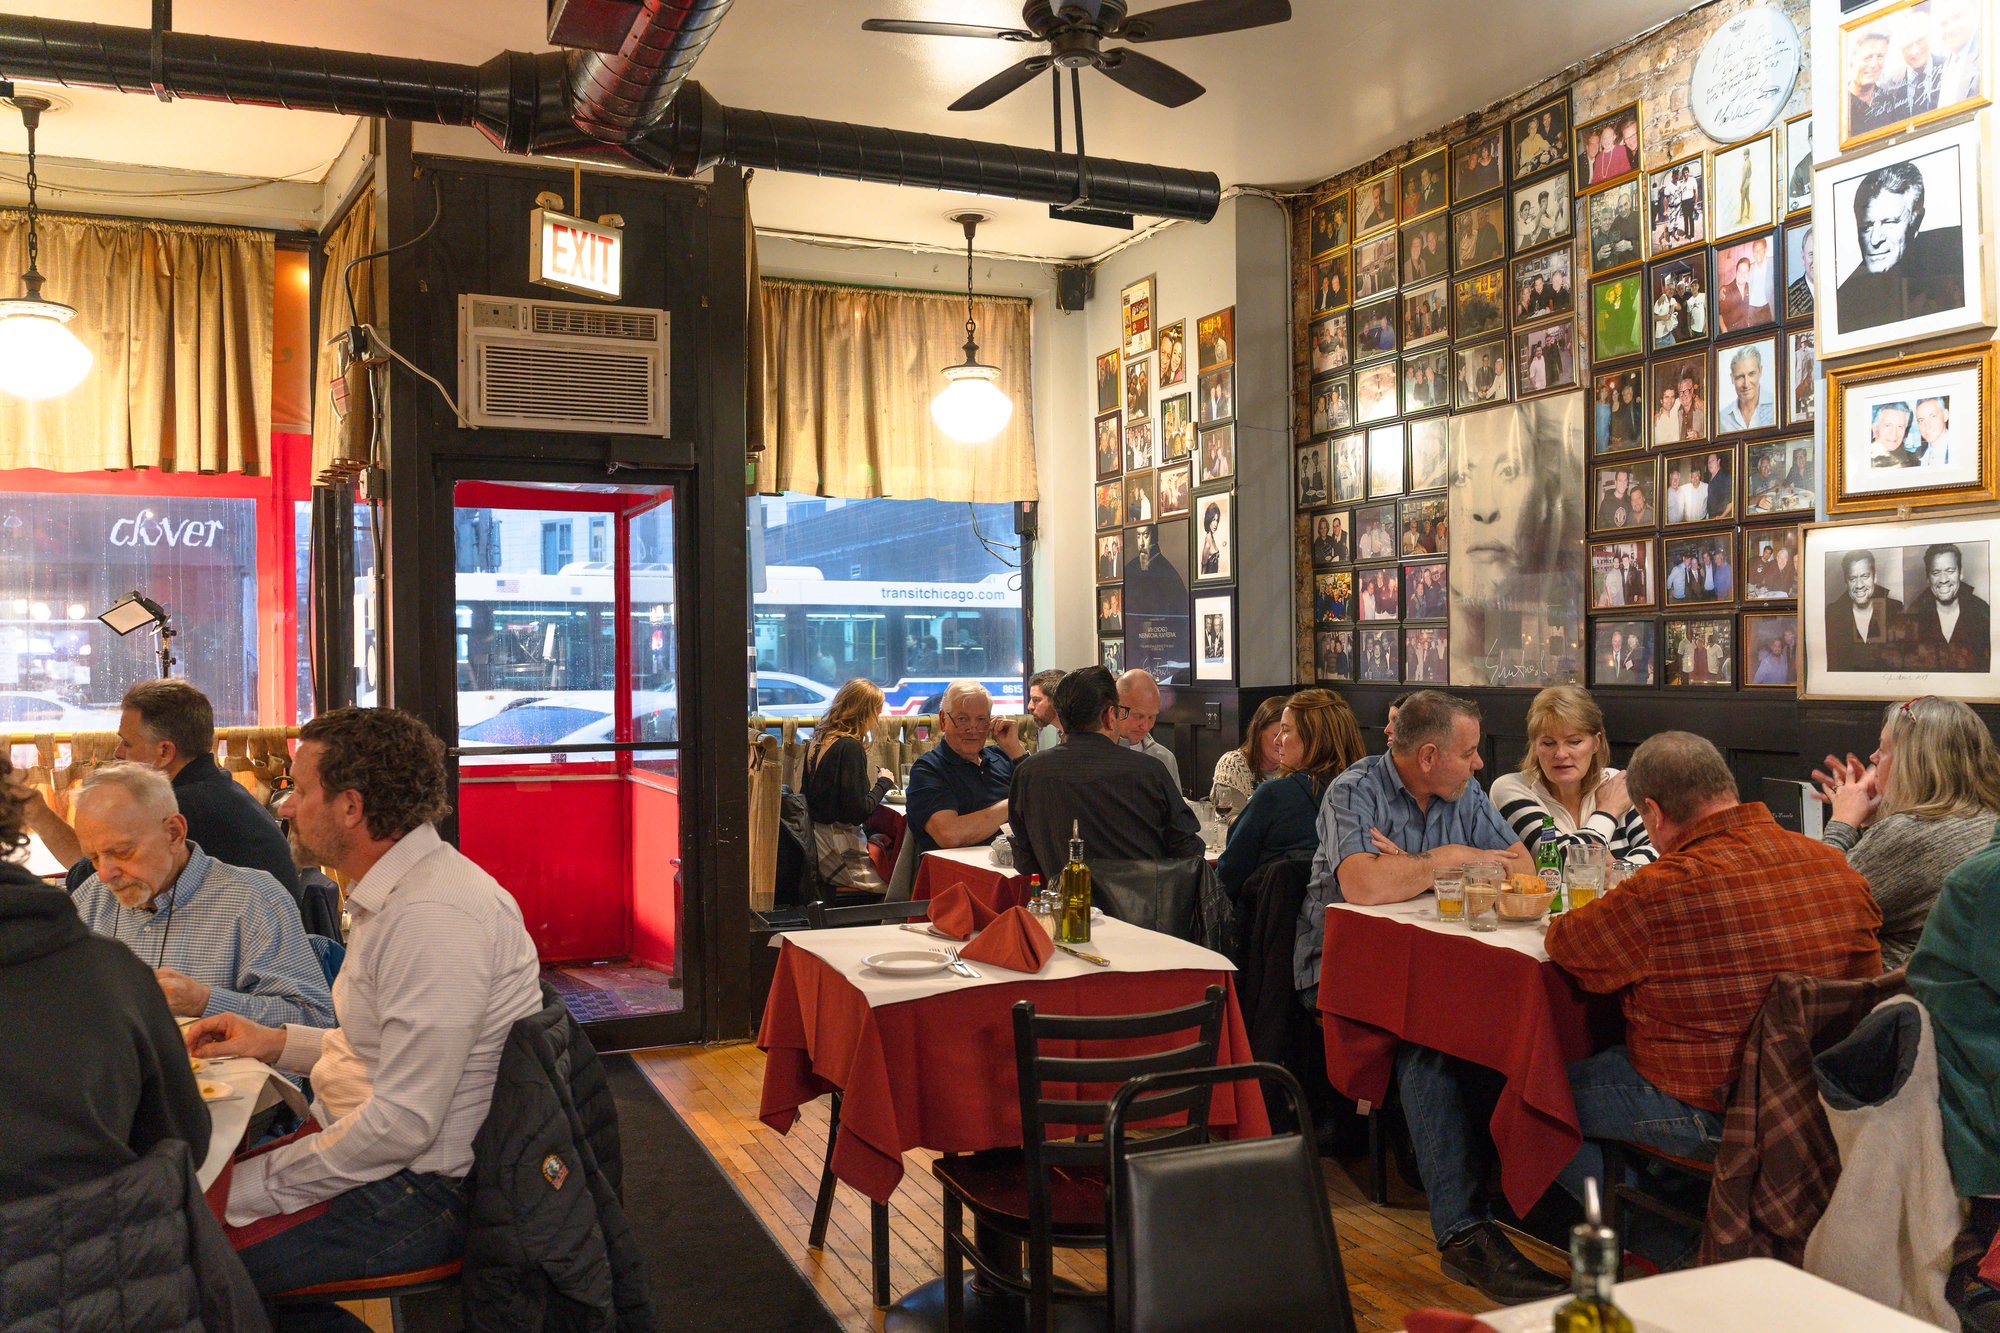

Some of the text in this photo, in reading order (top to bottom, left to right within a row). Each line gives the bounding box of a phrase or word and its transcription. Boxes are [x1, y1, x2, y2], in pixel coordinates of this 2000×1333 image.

[552, 223, 614, 285] EXIT
[110, 508, 223, 547] clover
[881, 586, 1005, 602] transitchicago.com
[1002, 684, 1023, 694] 8615
